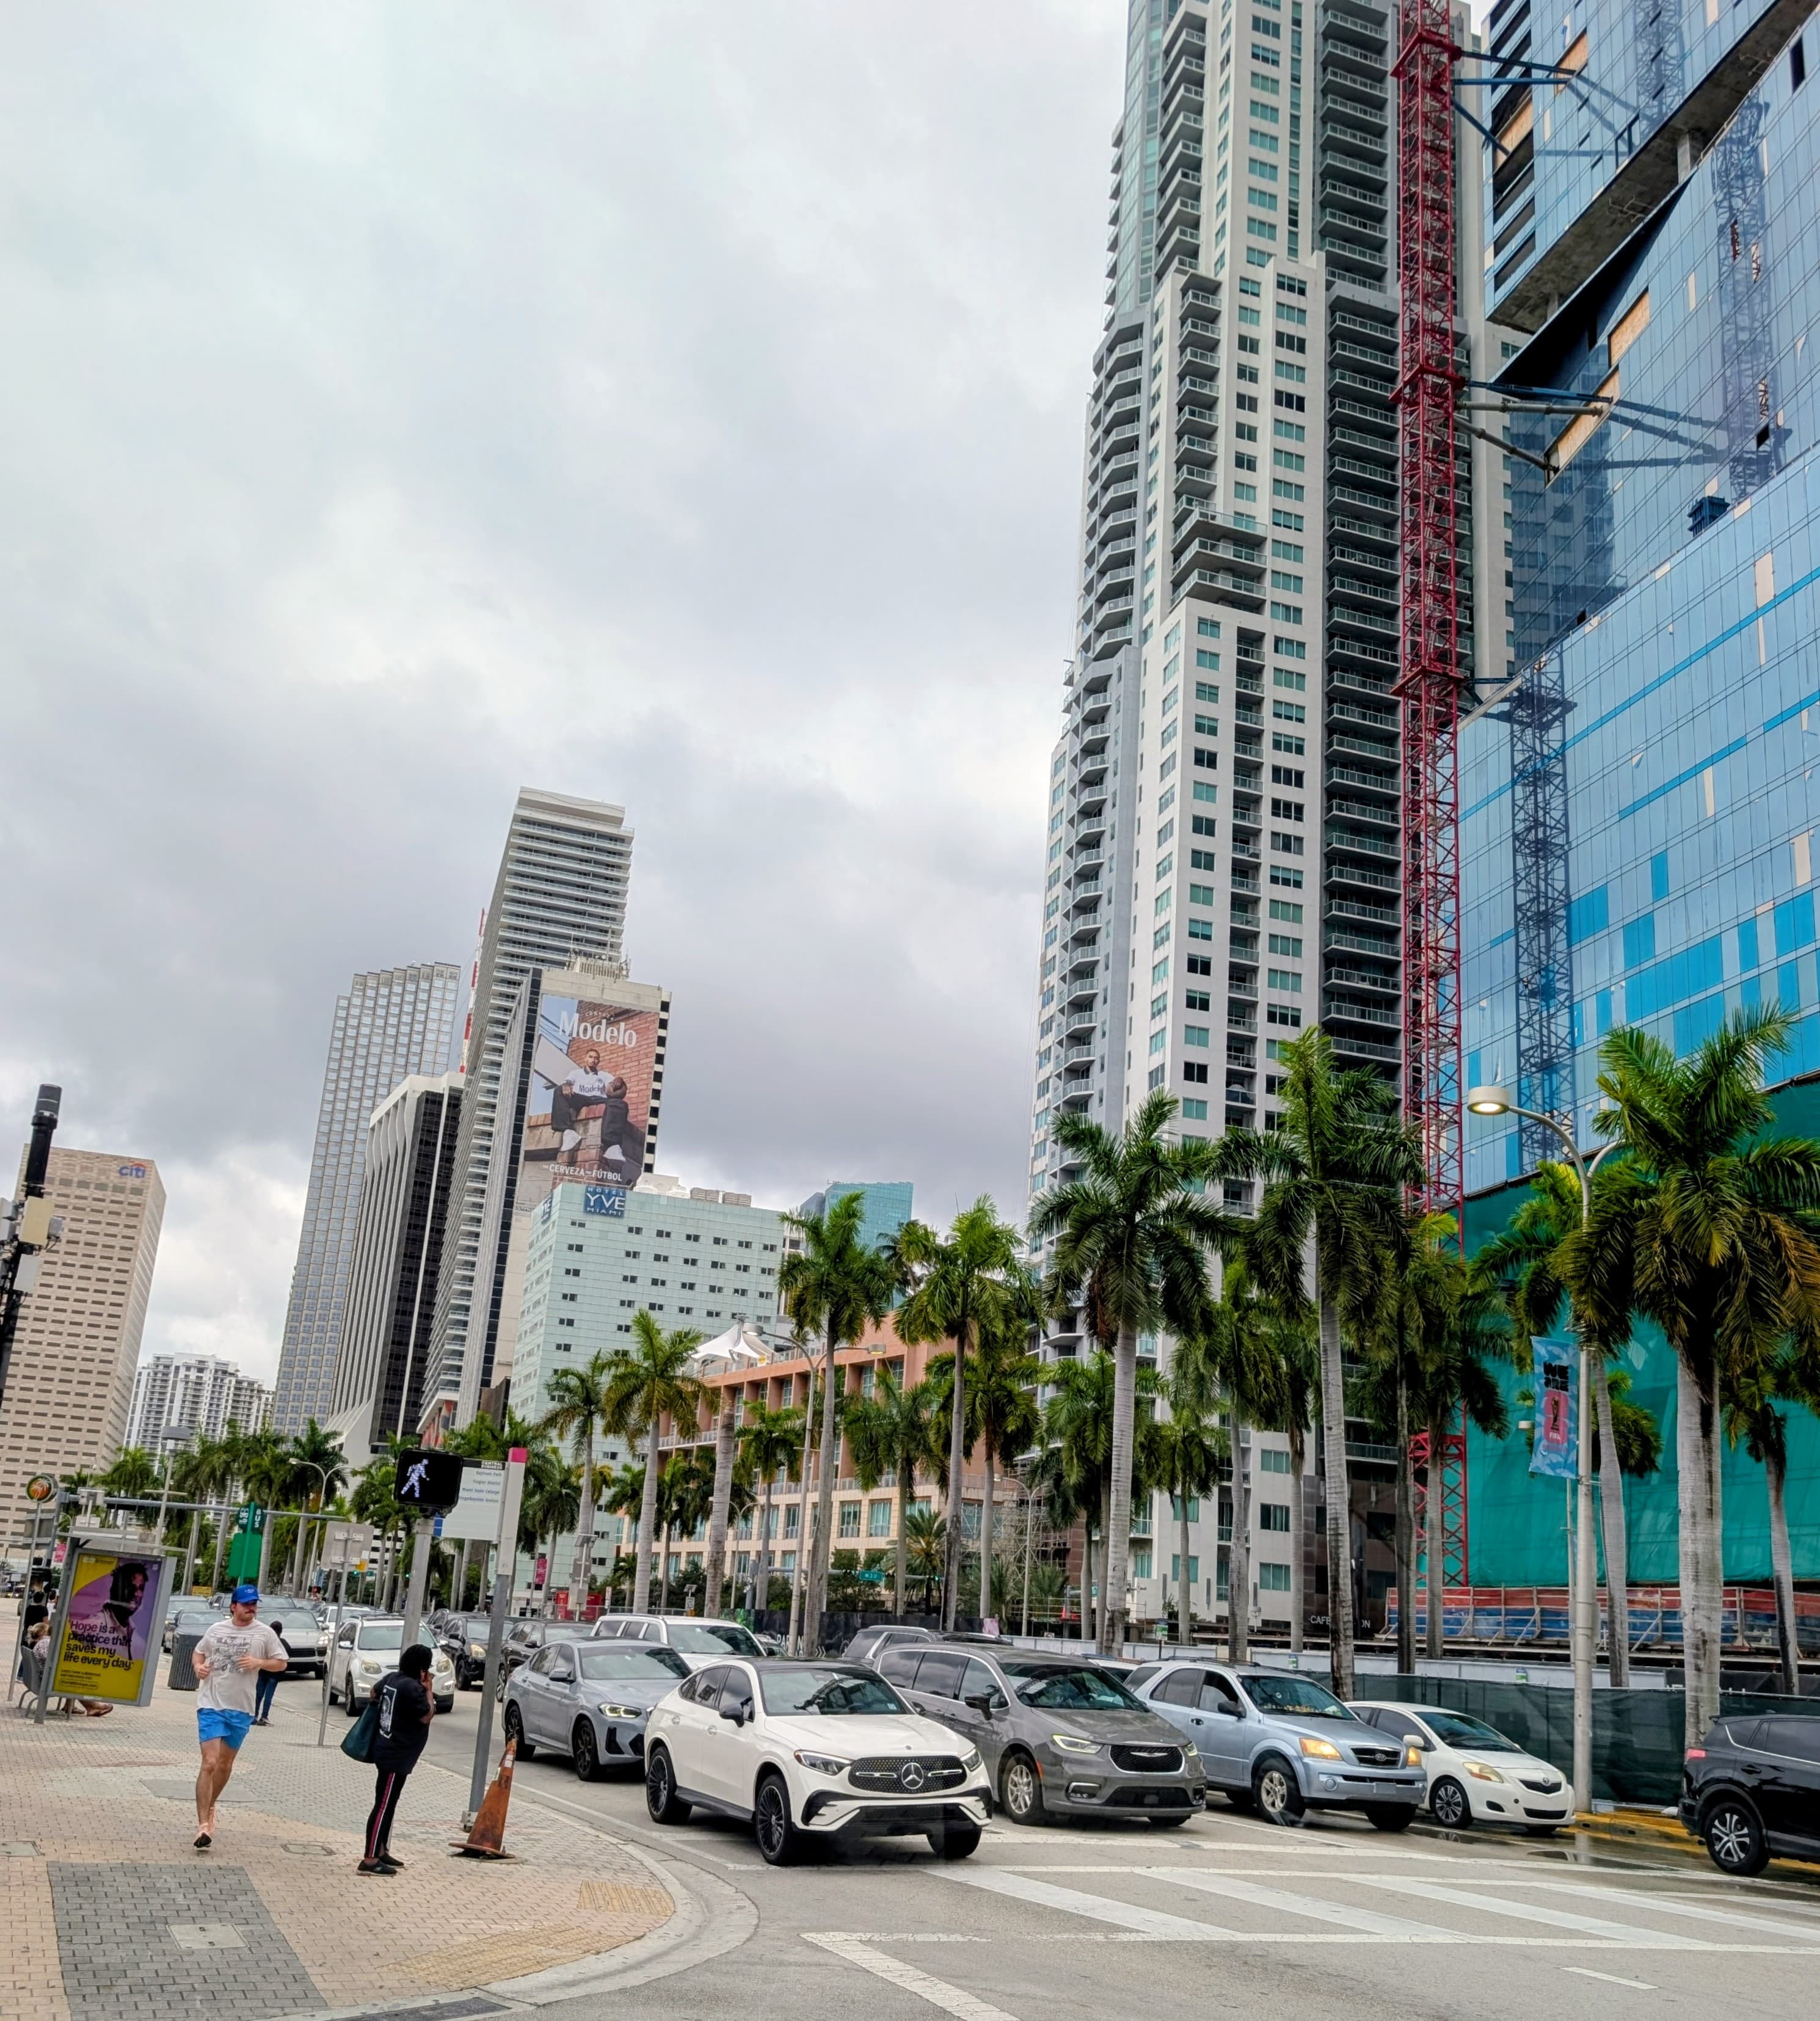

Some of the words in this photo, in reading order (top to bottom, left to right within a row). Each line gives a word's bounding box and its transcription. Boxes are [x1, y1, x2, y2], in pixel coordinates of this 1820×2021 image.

[558, 1010, 637, 1048] Modelo
[118, 1164, 147, 1179] citi
[550, 1163, 584, 1176] CERVEZA
[592, 1168, 622, 1182] FÚTBOL
[588, 1187, 624, 1196] HOTEL
[586, 1192, 626, 1211] YVE
[587, 1207, 622, 1216] MIAMI
[99, 1622, 107, 1633] is
[67, 1632, 111, 1645] practice
[112, 1636, 132, 1647] that
[66, 1642, 96, 1654] saves
[98, 1647, 116, 1658] my
[64, 1651, 79, 1662] life
[81, 1655, 111, 1669] every
